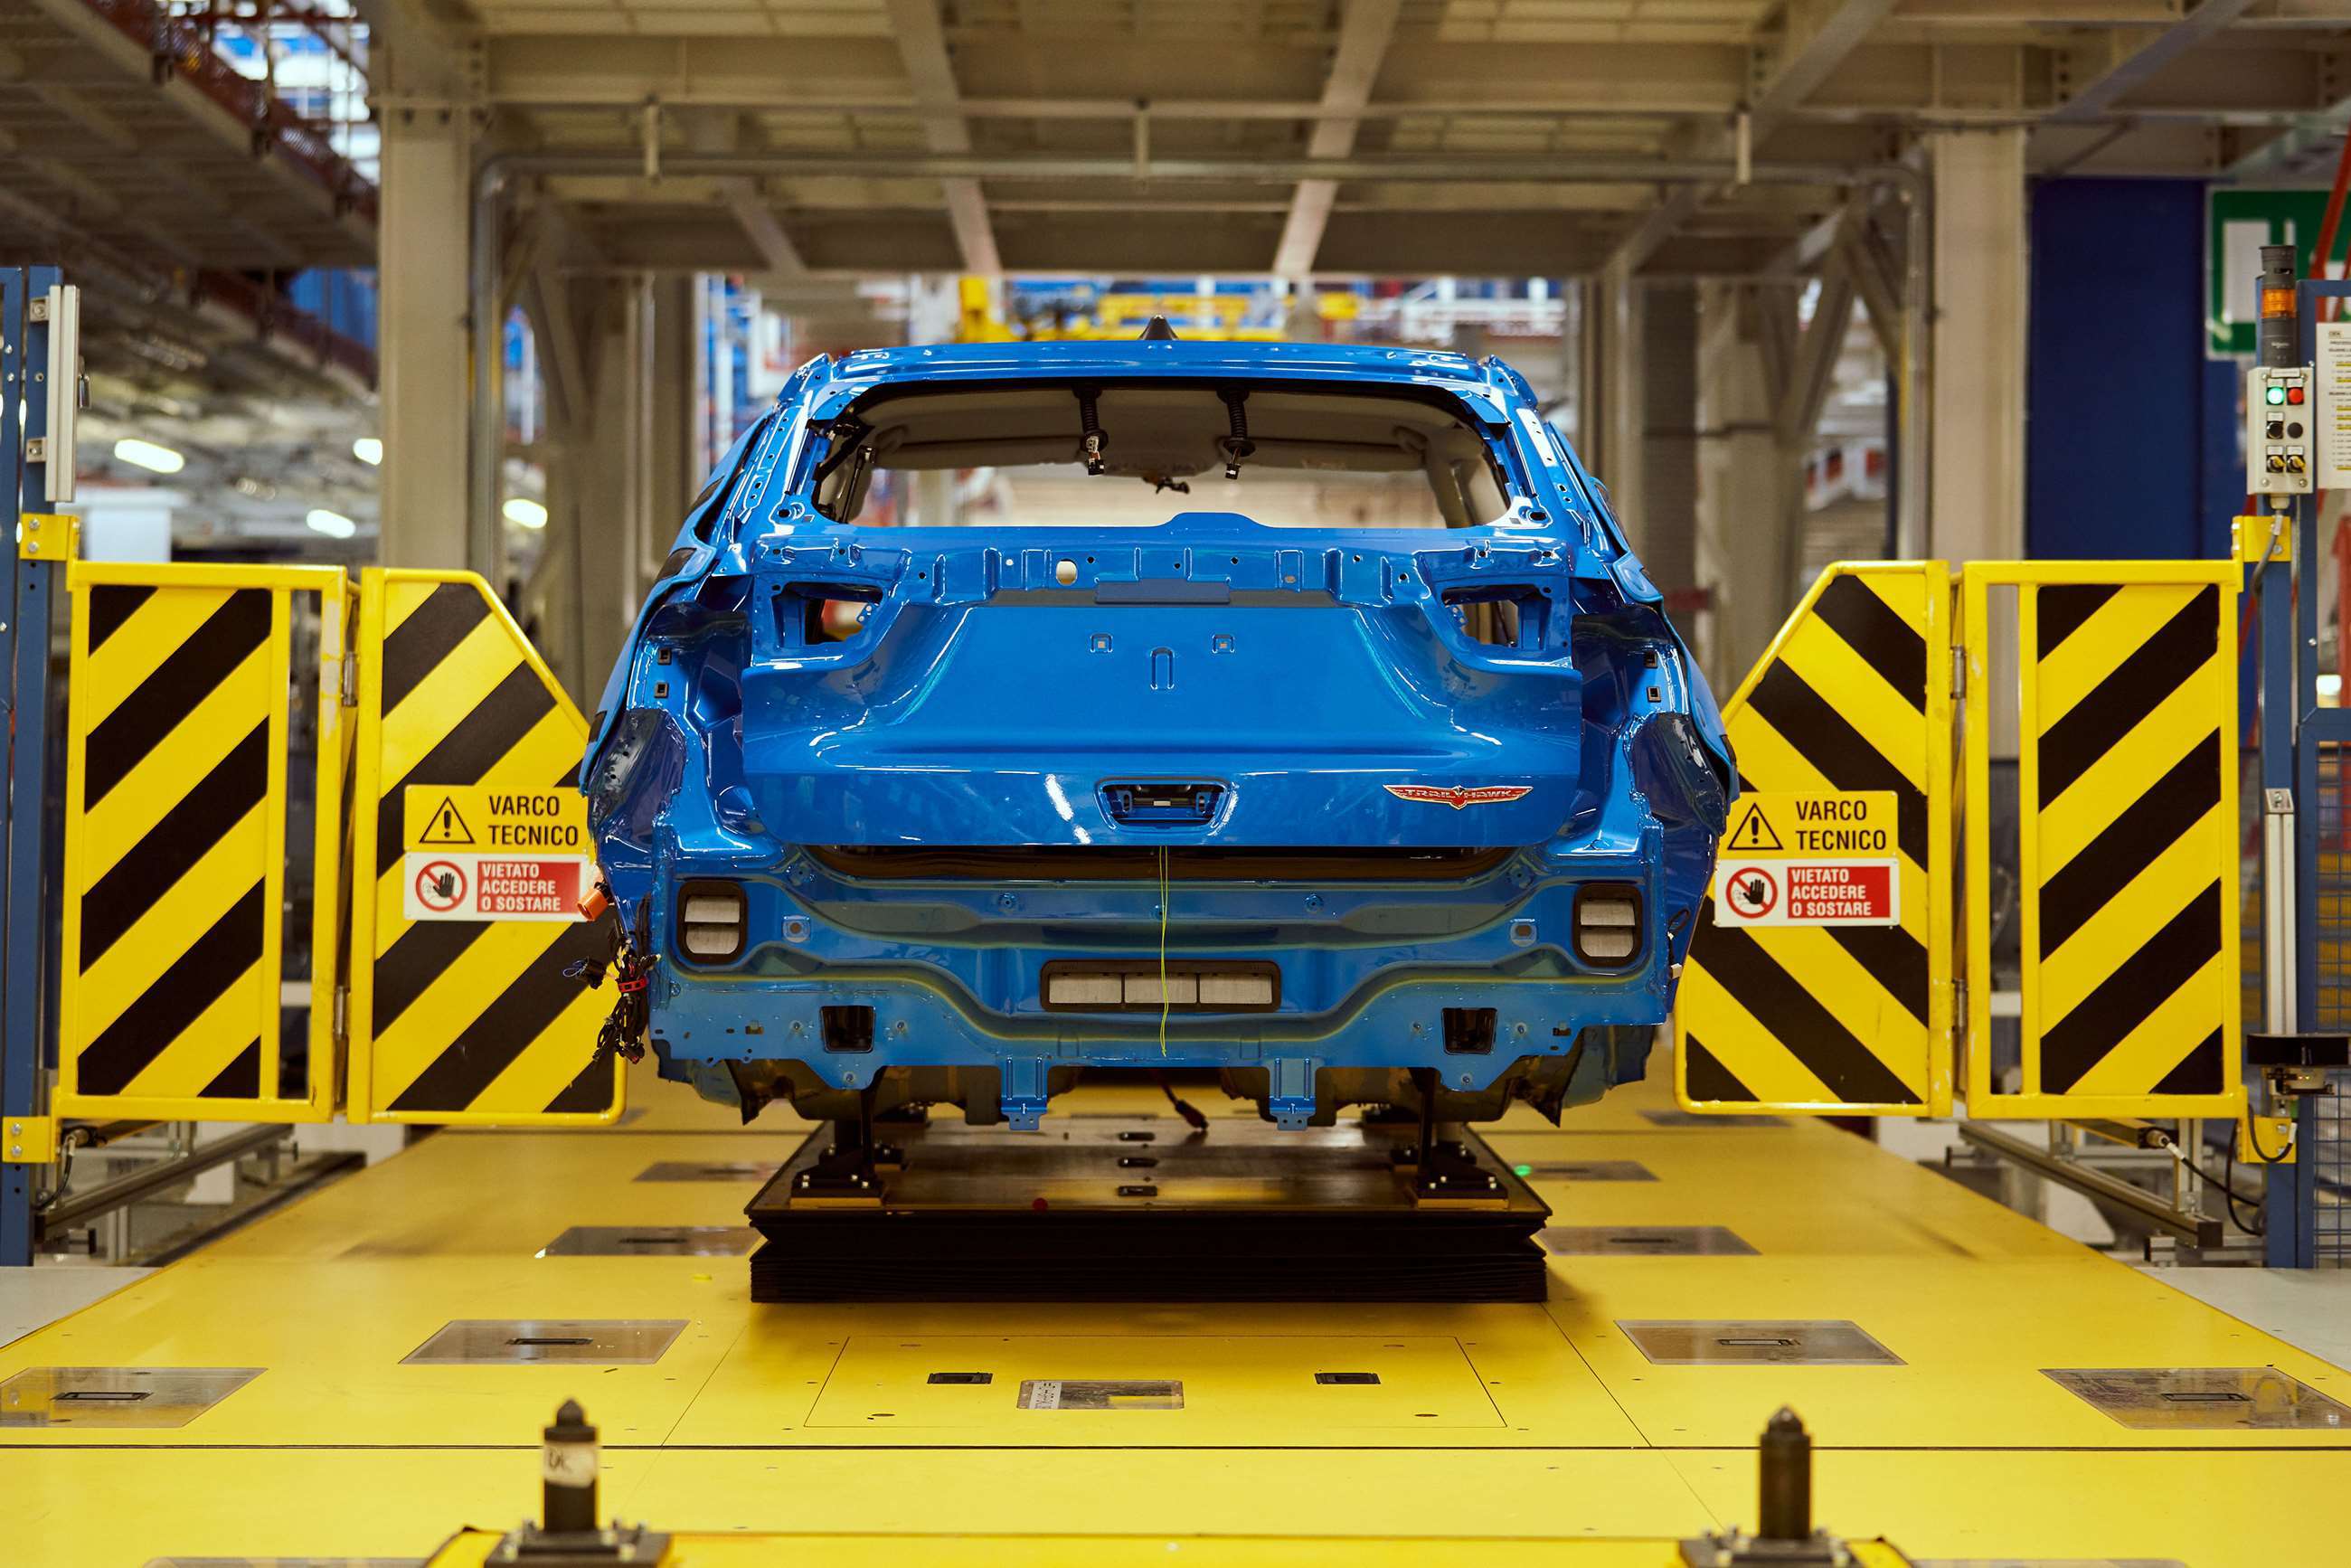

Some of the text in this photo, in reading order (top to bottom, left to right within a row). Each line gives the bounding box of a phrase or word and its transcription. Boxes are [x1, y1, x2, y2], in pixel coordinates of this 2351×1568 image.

[1405, 789, 1512, 798] TRAIL HAWK
[488, 796, 561, 817] VARCO
[1796, 800, 1867, 821] VARCO
[487, 825, 579, 846] TECNICO
[1796, 830, 1887, 851] TECNICO
[481, 864, 540, 877] VIETATO
[1791, 869, 1849, 883] VIETATO
[481, 880, 556, 895] ACCEDERE
[1791, 885, 1865, 900] ACCEDERE
[481, 897, 562, 912] O SOSTARE
[1792, 902, 1872, 916] O SOSTARE
